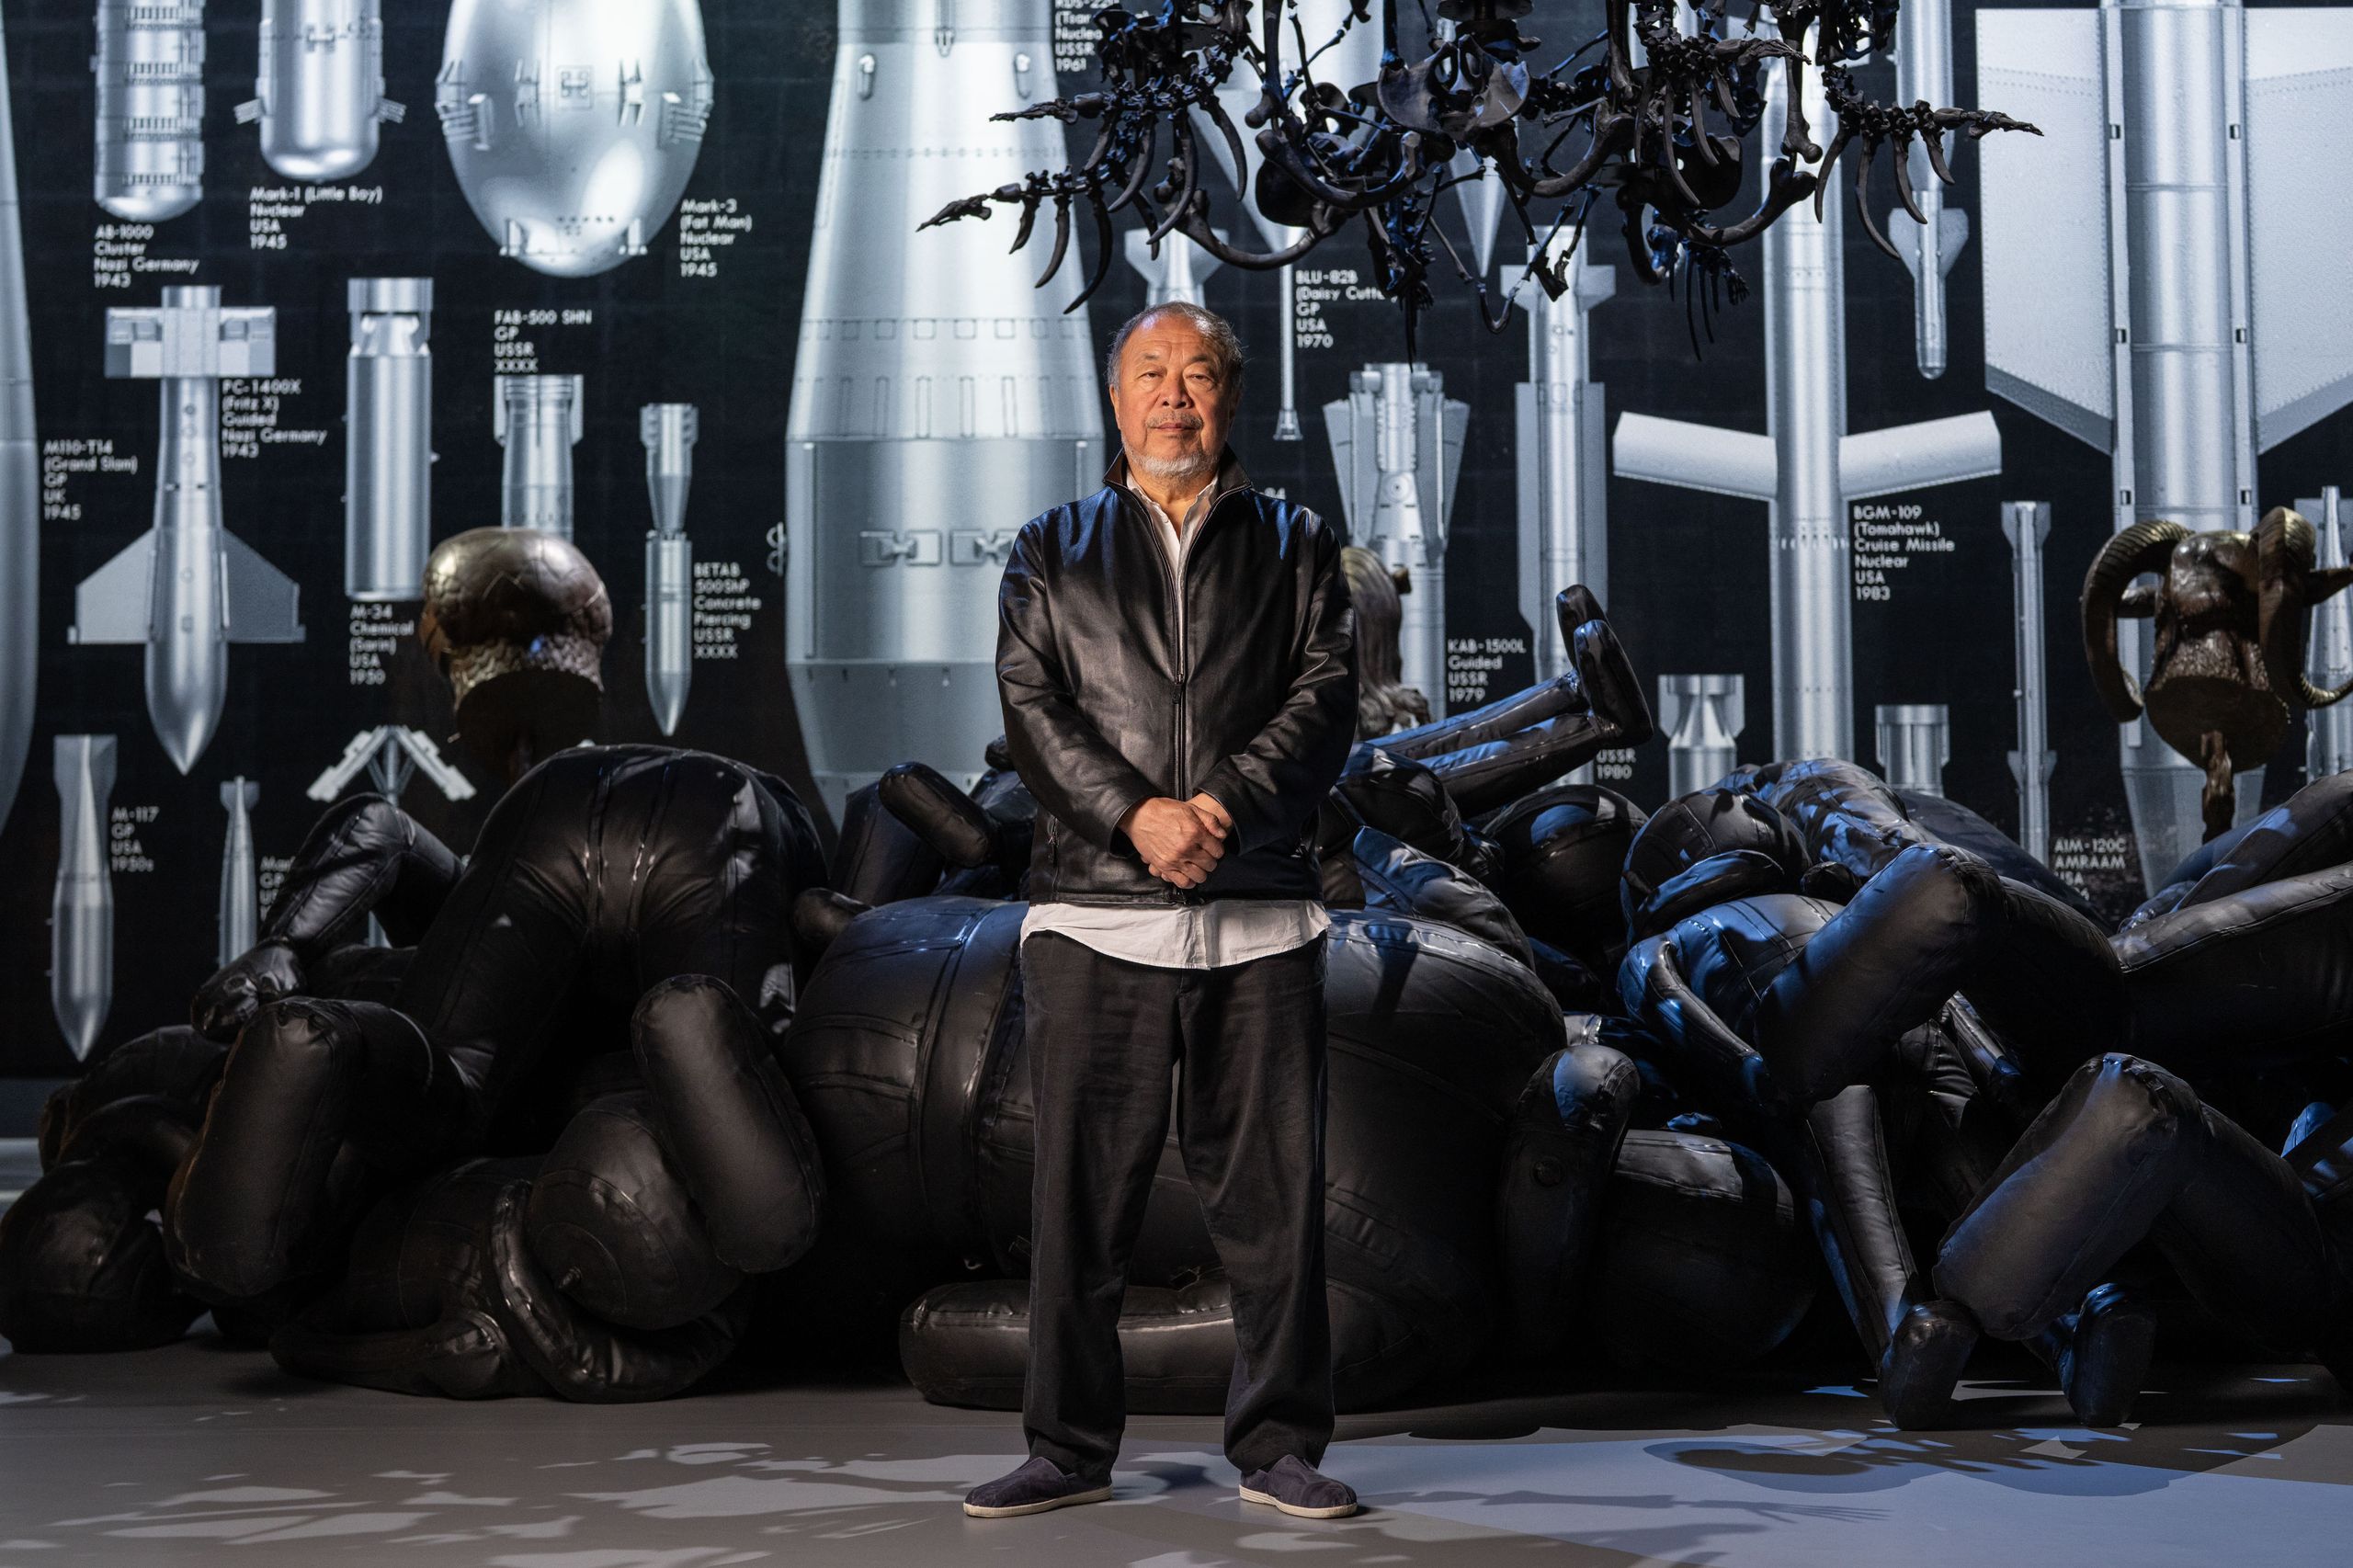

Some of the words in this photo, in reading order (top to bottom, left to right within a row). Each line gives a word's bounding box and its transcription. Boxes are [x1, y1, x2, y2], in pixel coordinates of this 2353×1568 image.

[1055, 0, 1120, 9] RDS-22
[1055, 26, 1103, 40] Nuclea
[1055, 42, 1095, 56] USSR
[1056, 58, 1086, 72] 1961
[250, 187, 300, 201] Mark-1
[305, 187, 345, 203] (Little
[349, 186, 382, 203] Boy)
[250, 203, 304, 217] Nuclear
[681, 199, 736, 213] Mark-3
[250, 219, 280, 233] USA
[680, 215, 709, 231] (Fat
[713, 215, 752, 232] Man)
[96, 224, 153, 239] AB-1000
[680, 231, 734, 244] Nuclear
[95, 241, 145, 256] Cluster
[251, 234, 287, 249] 1945
[680, 246, 710, 261] USA
[94, 257, 128, 270] Nazi
[132, 256, 199, 274] Germany
[681, 262, 717, 277] 1945
[95, 273, 131, 288] 1943
[1296, 270, 1358, 284] BLU-82B
[1296, 286, 1340, 301] (Daisy
[1346, 286, 1397, 302] Cutt
[1296, 301, 1320, 316] GP
[494, 310, 557, 324] FAB-500
[1296, 318, 1326, 332] USA
[494, 326, 518, 341] GP
[1297, 334, 1333, 347] 1970
[494, 342, 534, 357] USSR
[495, 358, 537, 372] XXXX
[222, 395, 258, 413] (Fritz
[263, 396, 279, 413] X)
[222, 413, 277, 426] Guided
[222, 428, 256, 443] Nazi
[260, 427, 326, 445] Germany
[44, 439, 112, 455] M110-T14
[222, 443, 258, 458] 1943
[44, 456, 97, 472] (Grand
[101, 456, 137, 474] Slam)
[44, 472, 67, 487] GP
[44, 489, 65, 504] UK
[45, 505, 81, 519] 1945
[1854, 506, 1922, 519] BGM-109
[1854, 521, 1939, 539] (Tomahawk)
[1855, 537, 1899, 551] Cruise
[1905, 538, 1955, 551] Missile
[1855, 554, 1908, 568] Nuclear
[694, 562, 740, 577] BETAB
[1856, 570, 1884, 584] USA
[1857, 585, 1890, 600] 1983
[694, 596, 761, 610] Concrete
[350, 620, 414, 635] Chemical
[694, 611, 751, 631] Piercing
[694, 628, 733, 642] USSR
[695, 644, 737, 658] XXXX
[1448, 639, 1526, 653] KAB-1500L
[350, 653, 380, 668] USA
[1449, 655, 1502, 669] Guided
[1449, 671, 1487, 686] USSR
[1449, 687, 1485, 701] 1979
[1597, 748, 1636, 763] USSR
[1597, 765, 1631, 779] 1980
[112, 823, 134, 839] GP
[111, 838, 142, 855] USA
[2055, 837, 2126, 853] AIM-120C
[261, 857, 295, 871] Mar
[2055, 855, 2125, 869] AMRAAM
[260, 873, 284, 888] GP
